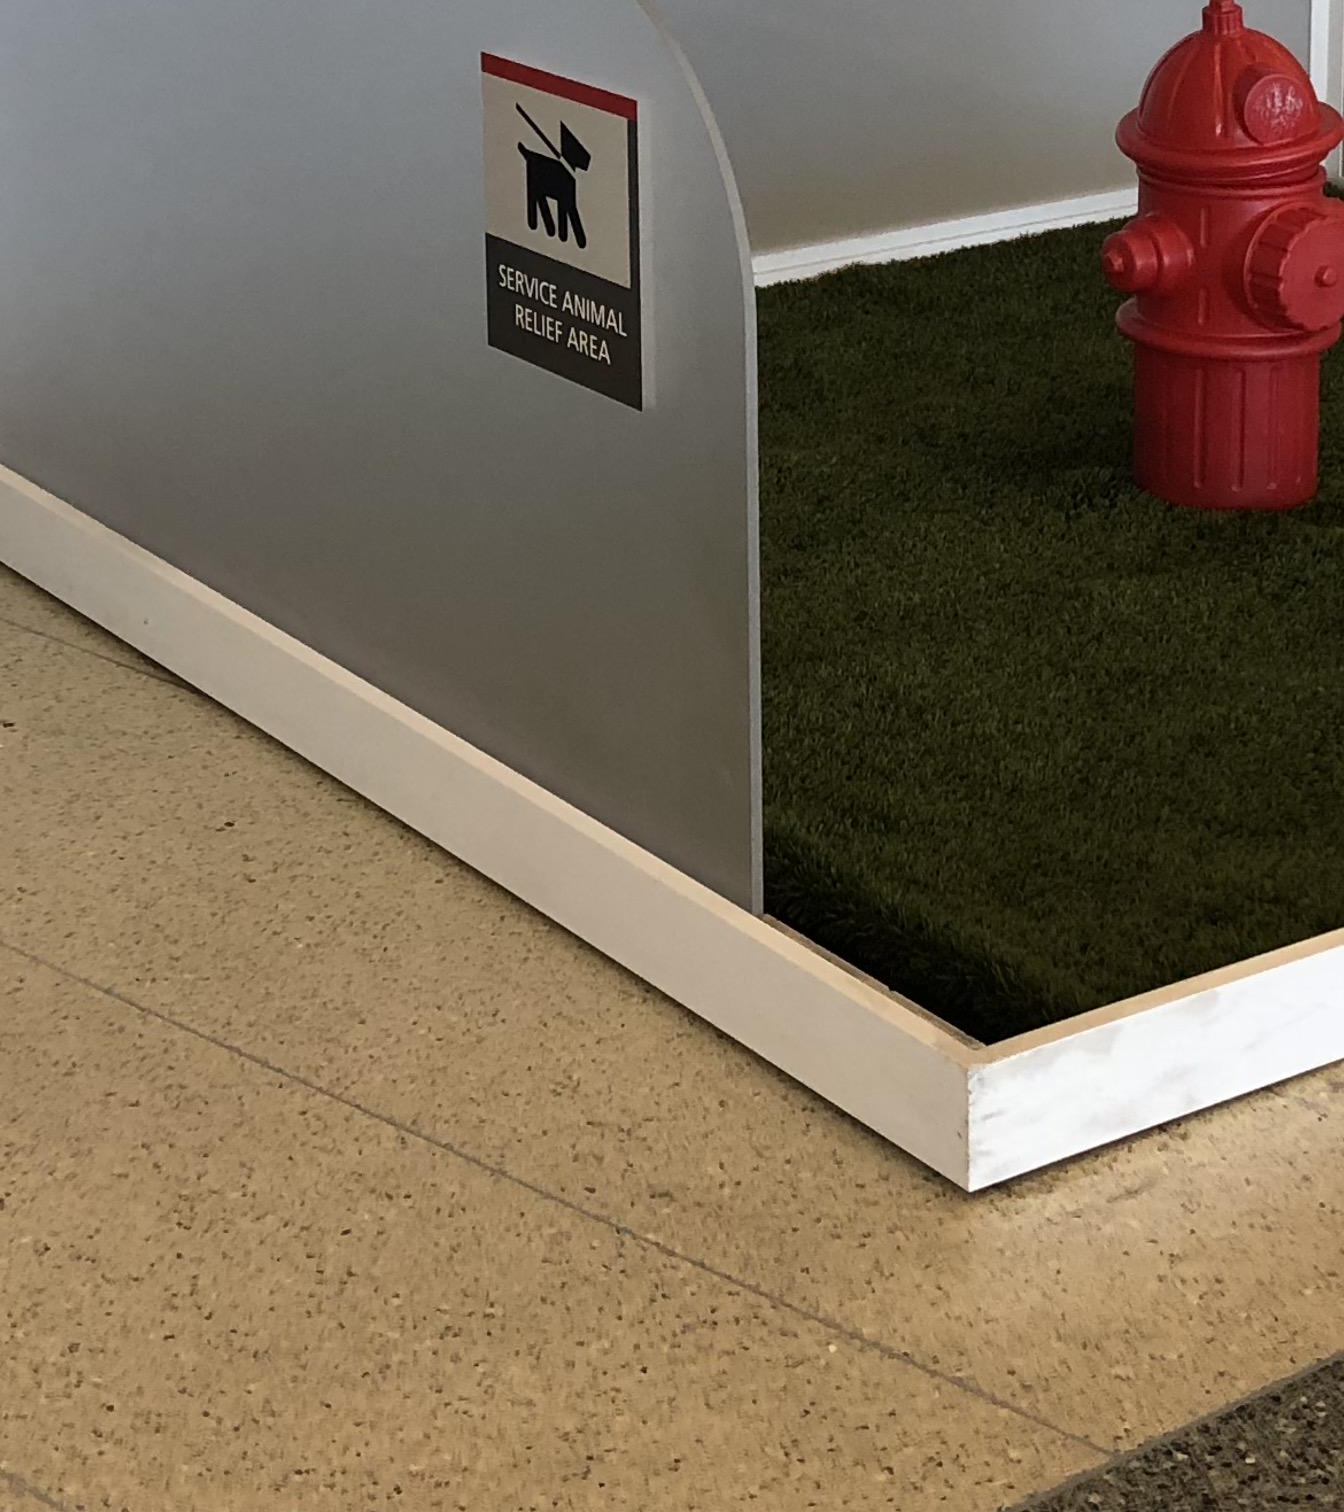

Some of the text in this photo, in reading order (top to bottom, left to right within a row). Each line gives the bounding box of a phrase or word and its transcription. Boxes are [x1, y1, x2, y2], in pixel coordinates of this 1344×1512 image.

[498, 263, 628, 337] SERVICE ANIMAL
[514, 303, 611, 366] RELIEF AREA
